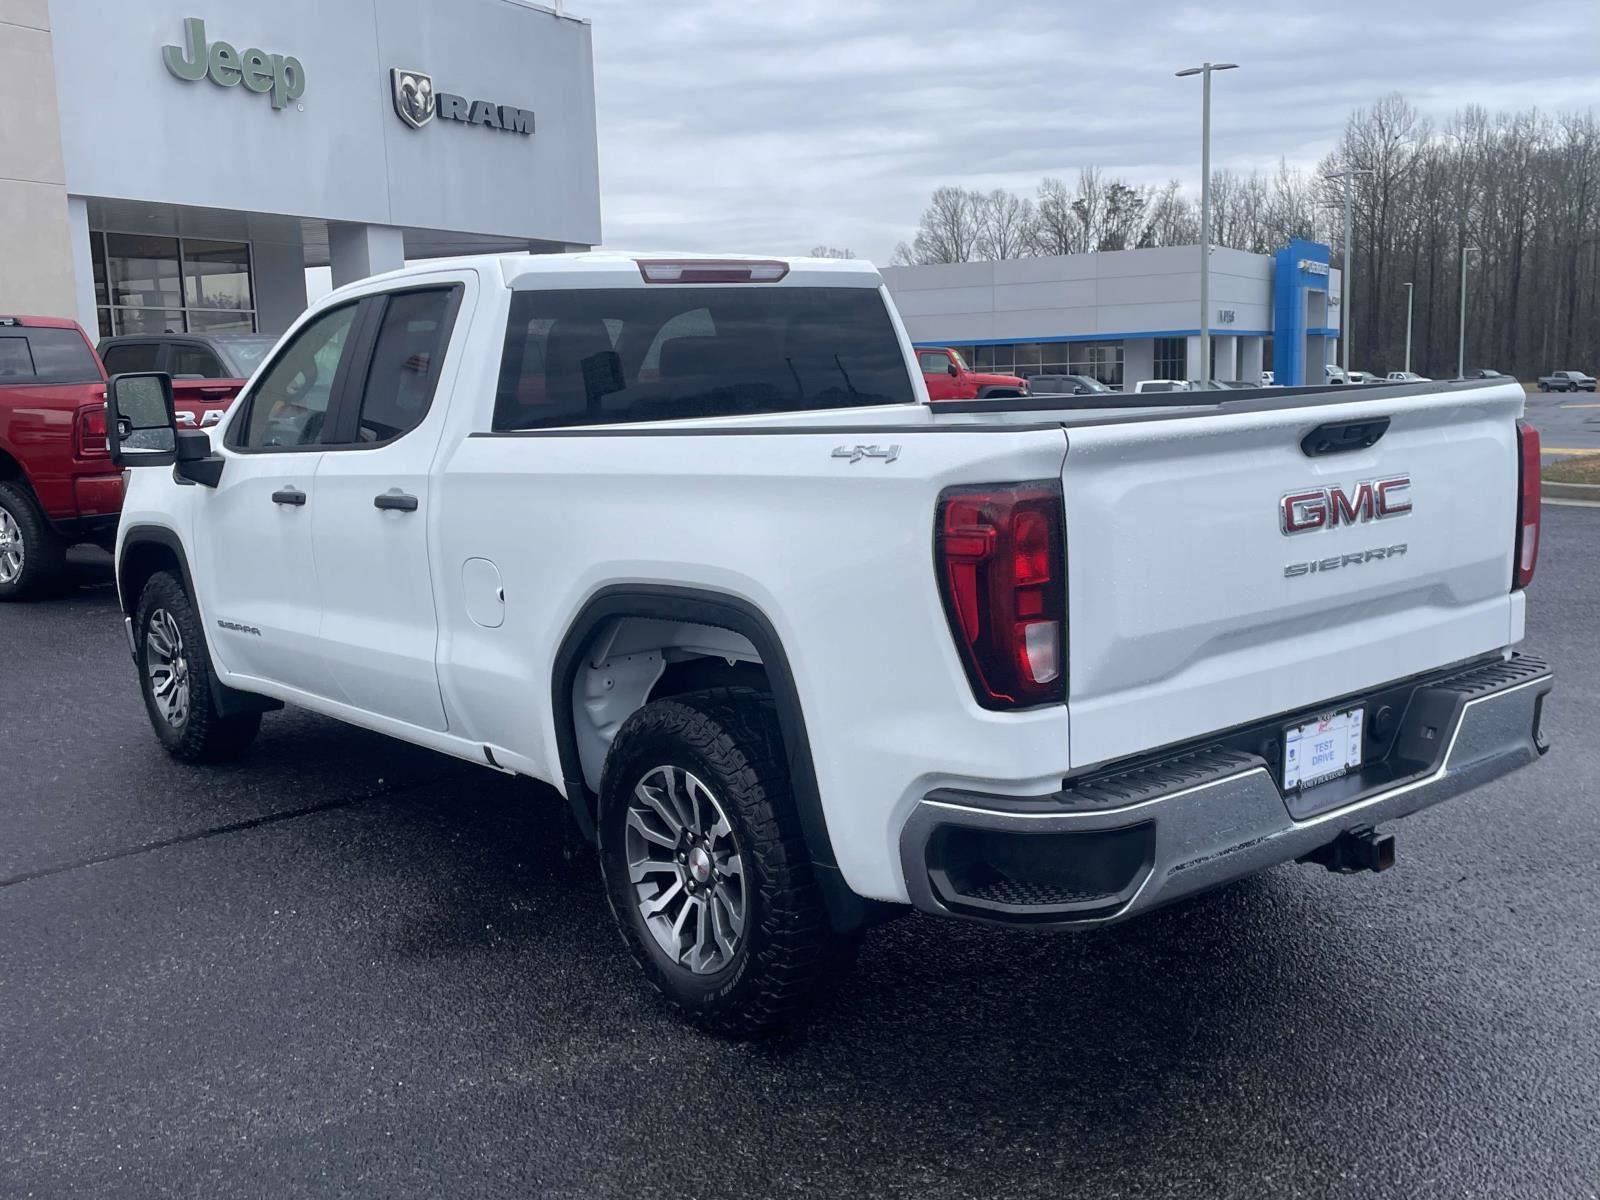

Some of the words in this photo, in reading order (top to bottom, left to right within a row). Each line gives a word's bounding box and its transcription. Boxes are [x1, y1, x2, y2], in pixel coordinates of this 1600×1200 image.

[162, 17, 306, 110] Jeep
[435, 92, 536, 135] RAM
[175, 409, 226, 427] RA
[1279, 473, 1414, 537] GMC
[1284, 543, 1408, 577] SIERRA
[1312, 750, 1335, 766] DRIVE
[1314, 739, 1334, 754] TEST
